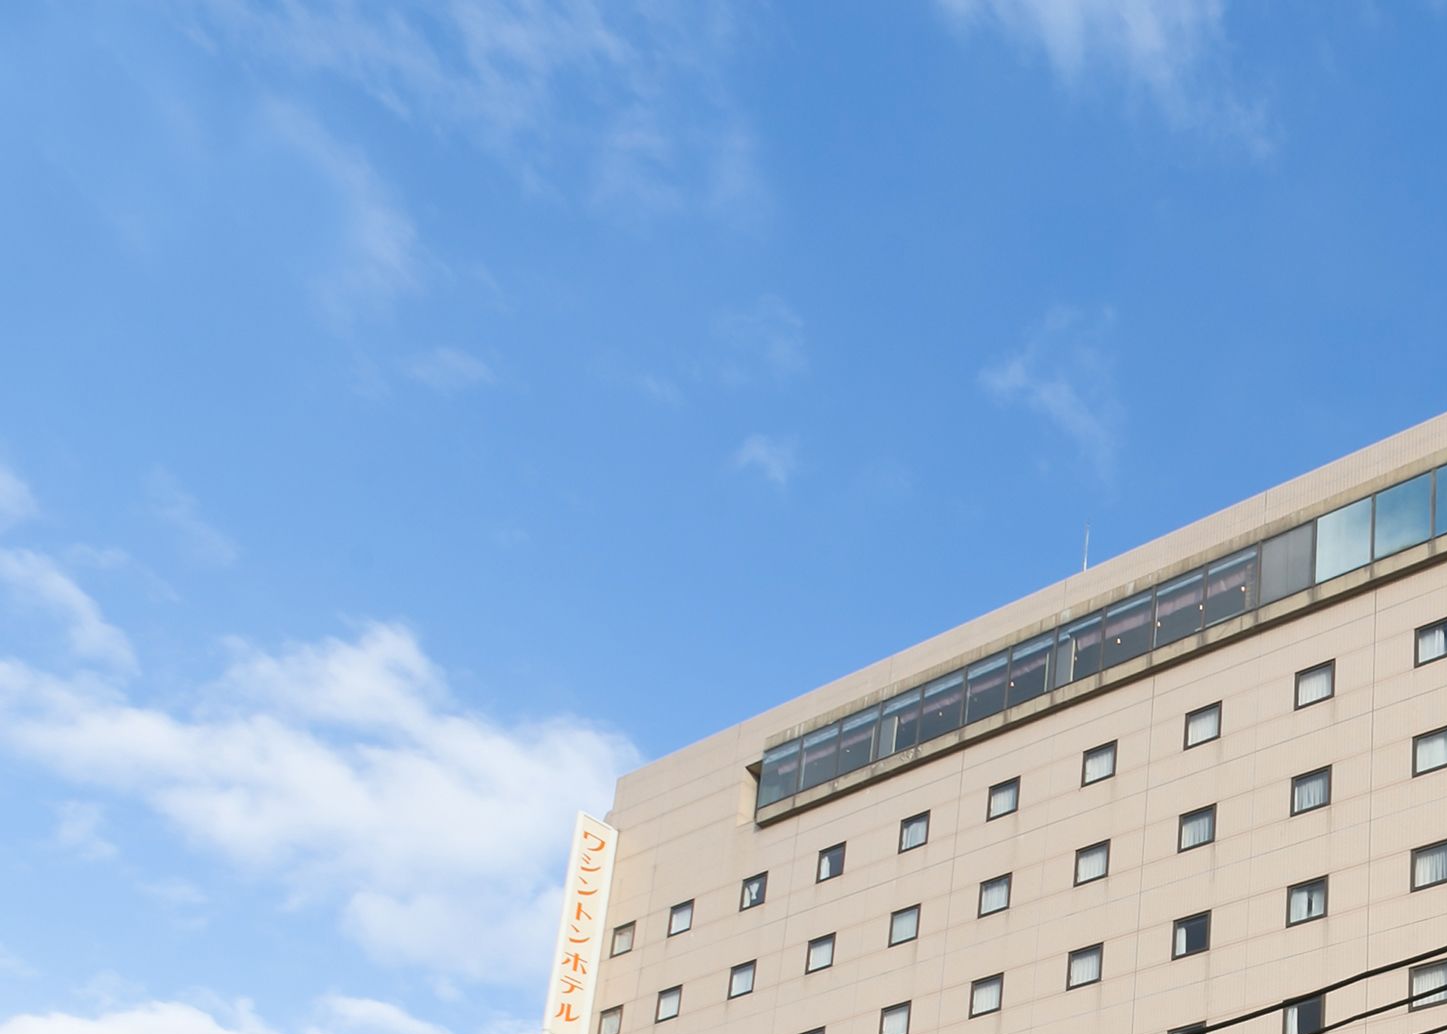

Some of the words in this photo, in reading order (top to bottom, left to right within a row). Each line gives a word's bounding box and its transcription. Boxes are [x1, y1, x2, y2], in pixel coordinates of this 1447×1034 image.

[555, 831, 606, 1022] ワシントンホテル
